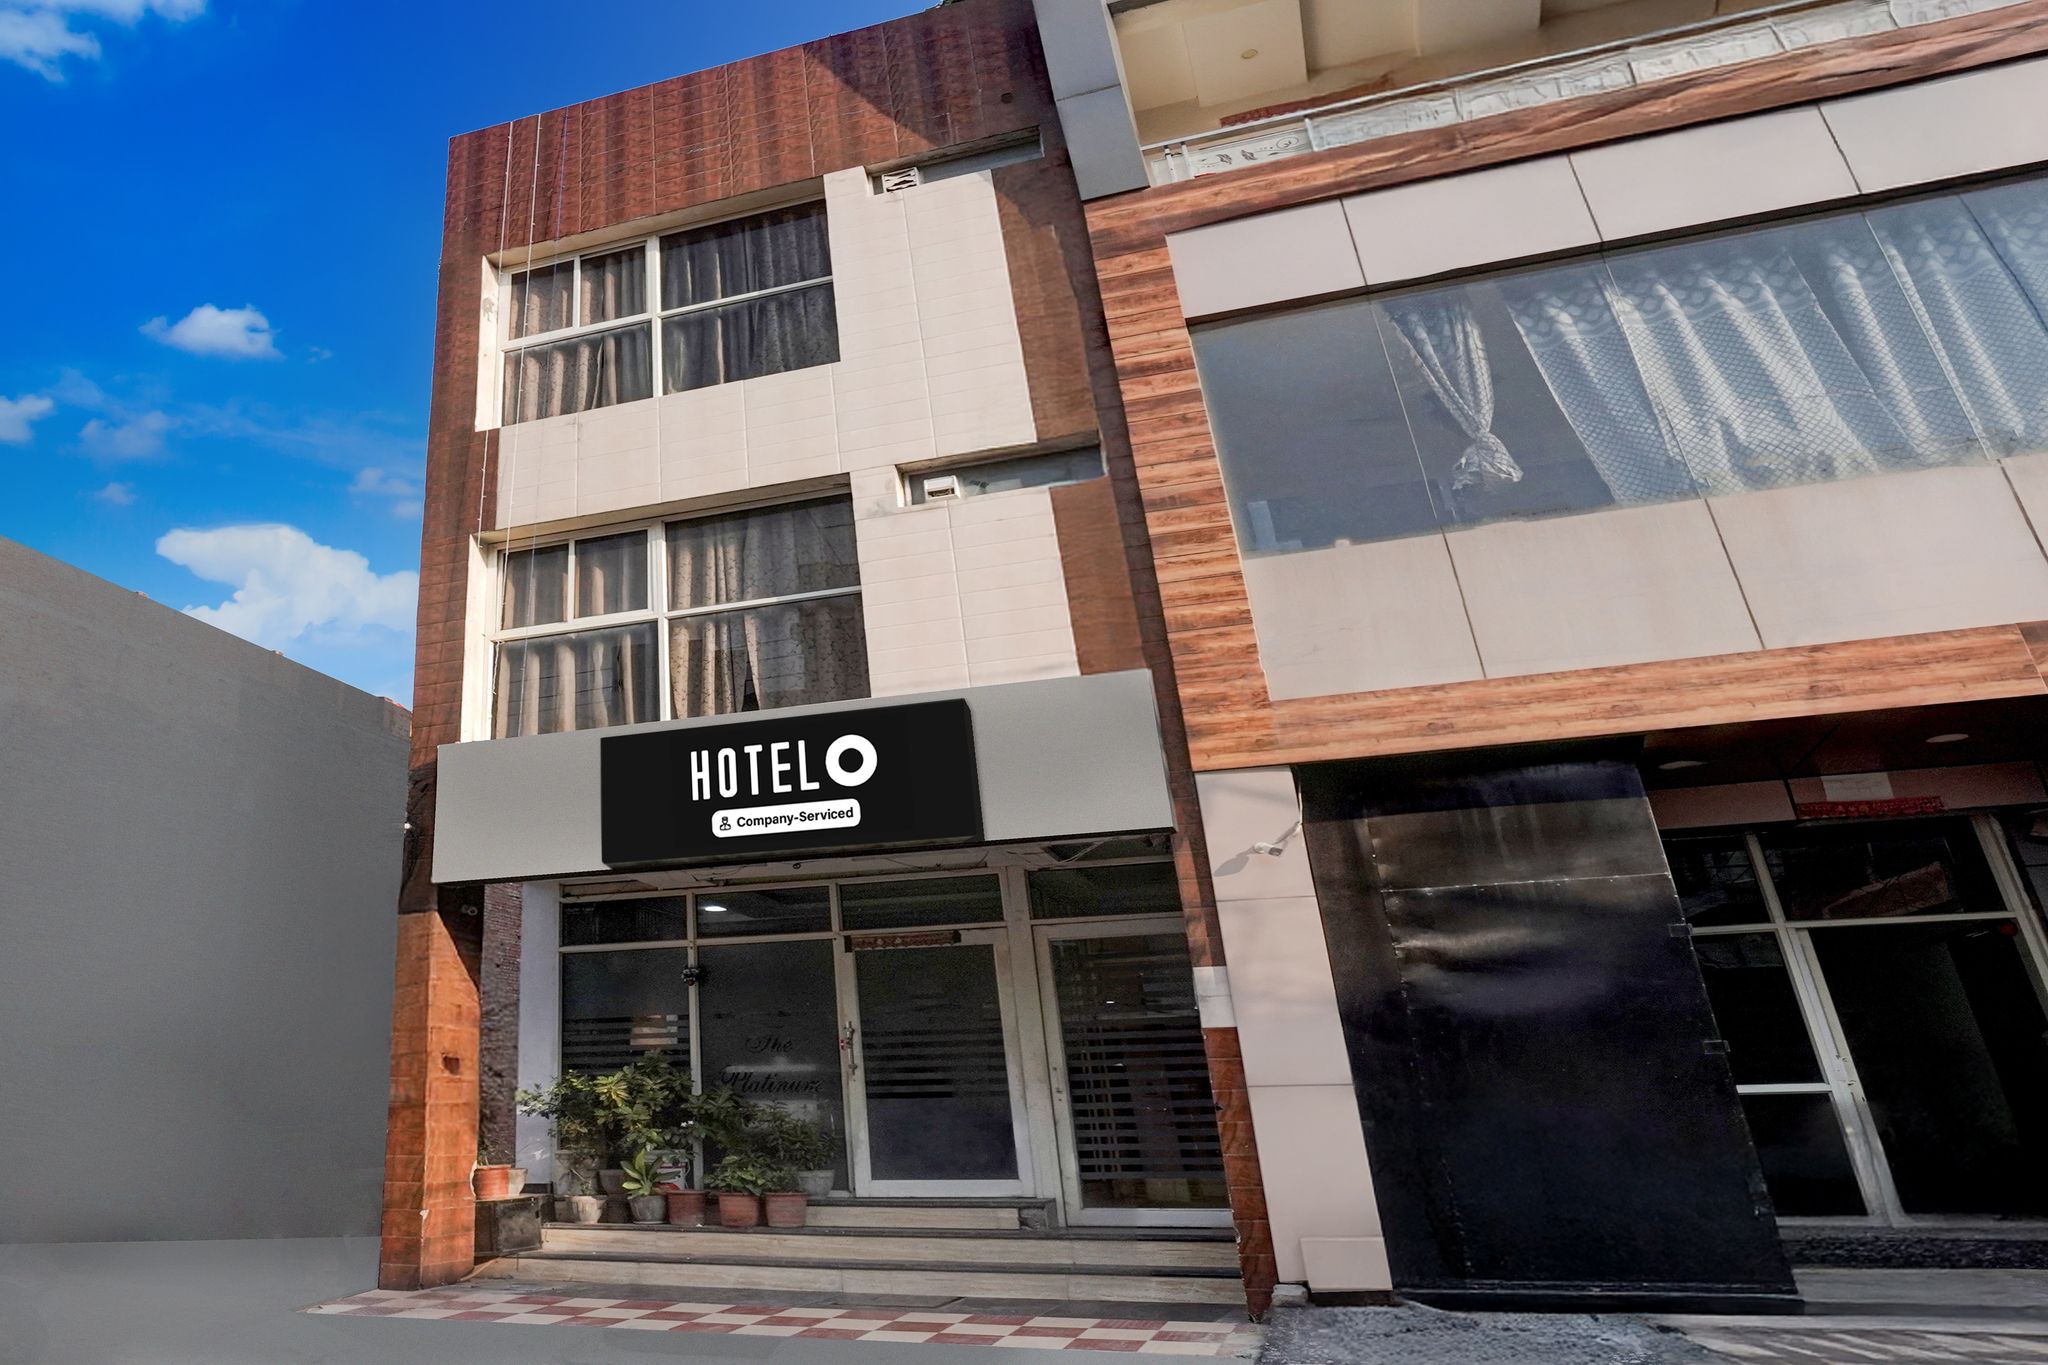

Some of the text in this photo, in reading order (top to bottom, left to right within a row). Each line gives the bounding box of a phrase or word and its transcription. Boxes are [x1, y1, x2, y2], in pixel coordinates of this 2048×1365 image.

[736, 806, 854, 828] Company-Serviced
[745, 1034, 794, 1053] The
[720, 1065, 824, 1093] Platinum
